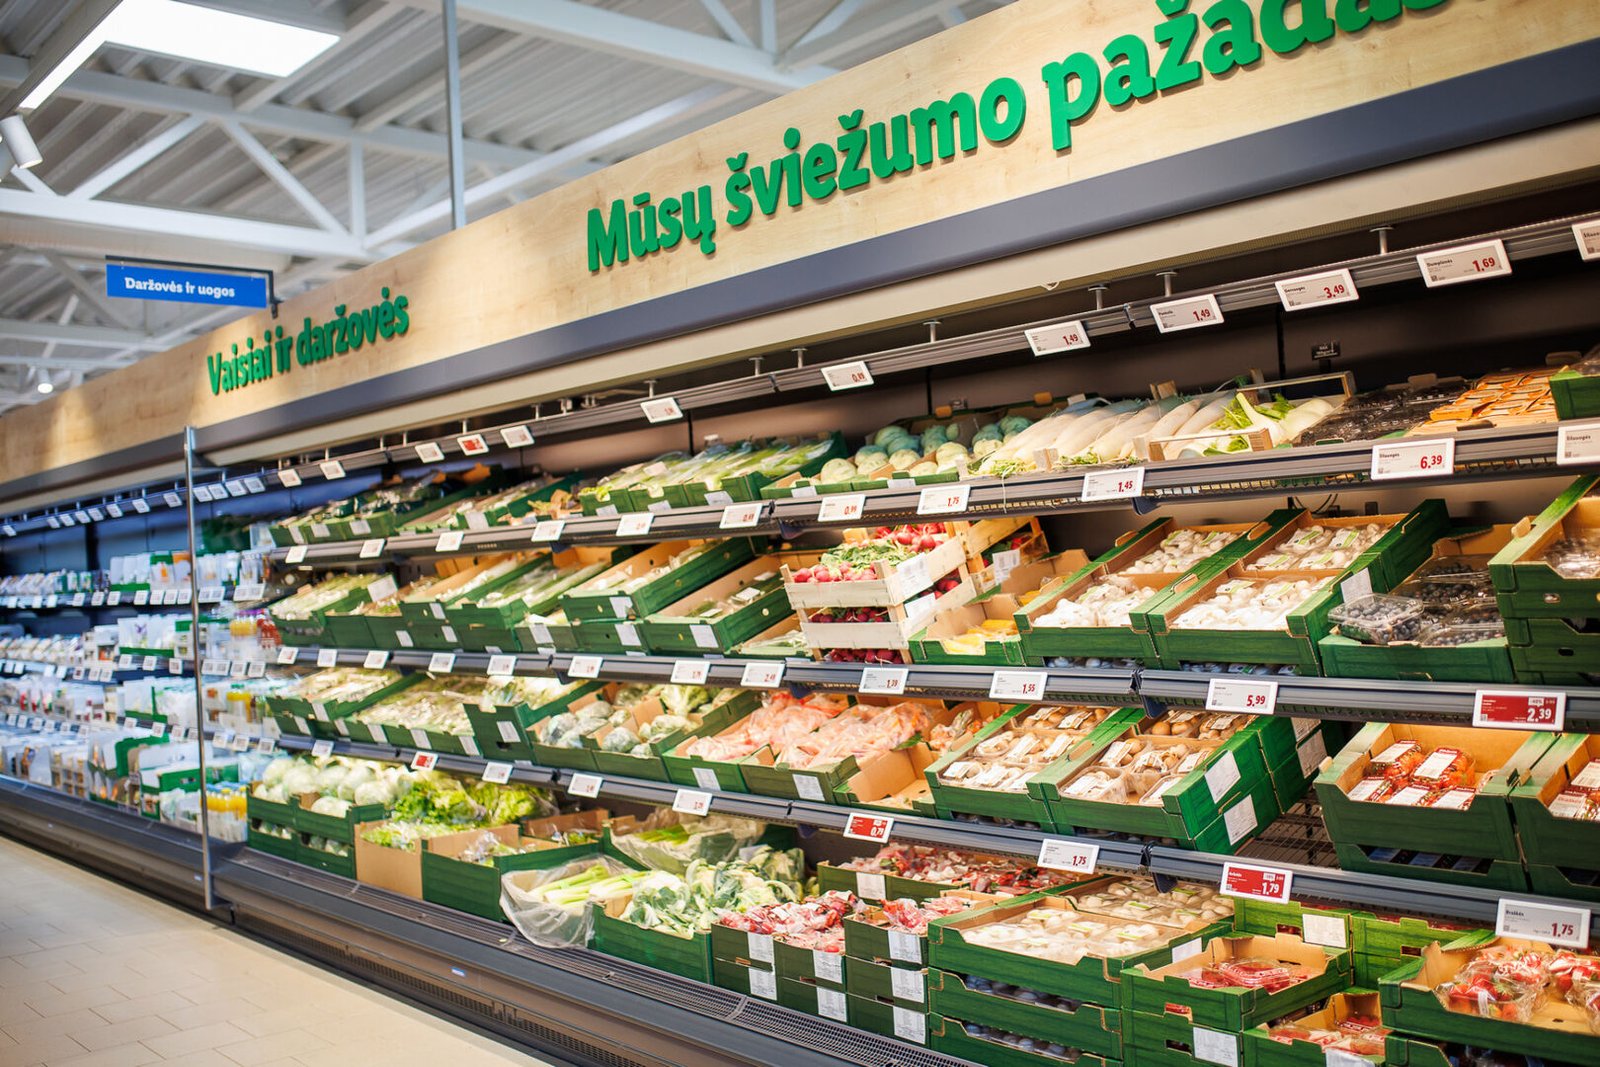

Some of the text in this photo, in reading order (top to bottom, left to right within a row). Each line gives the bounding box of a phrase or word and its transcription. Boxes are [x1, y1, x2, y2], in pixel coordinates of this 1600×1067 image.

[586, 0, 1443, 272] Mūsų šviežumo pažad
[1472, 257, 1496, 273] 1.69
[124, 276, 236, 301] Daržovės ir uogos
[1324, 284, 1345, 299] 3.49
[1193, 308, 1211, 322] 1.49
[206, 287, 411, 396] Vaisiai ir daržovės
[1062, 333, 1079, 346] 1.49
[1420, 454, 1443, 470] 6.39
[1118, 480, 1134, 493] 1.45
[1022, 683, 1036, 694] 1.55
[1246, 695, 1266, 707] 5.99
[1526, 707, 1553, 722] 2.39
[1072, 855, 1088, 867] 1.75
[1261, 881, 1280, 895] 1.79
[1551, 922, 1574, 938] 1.75
